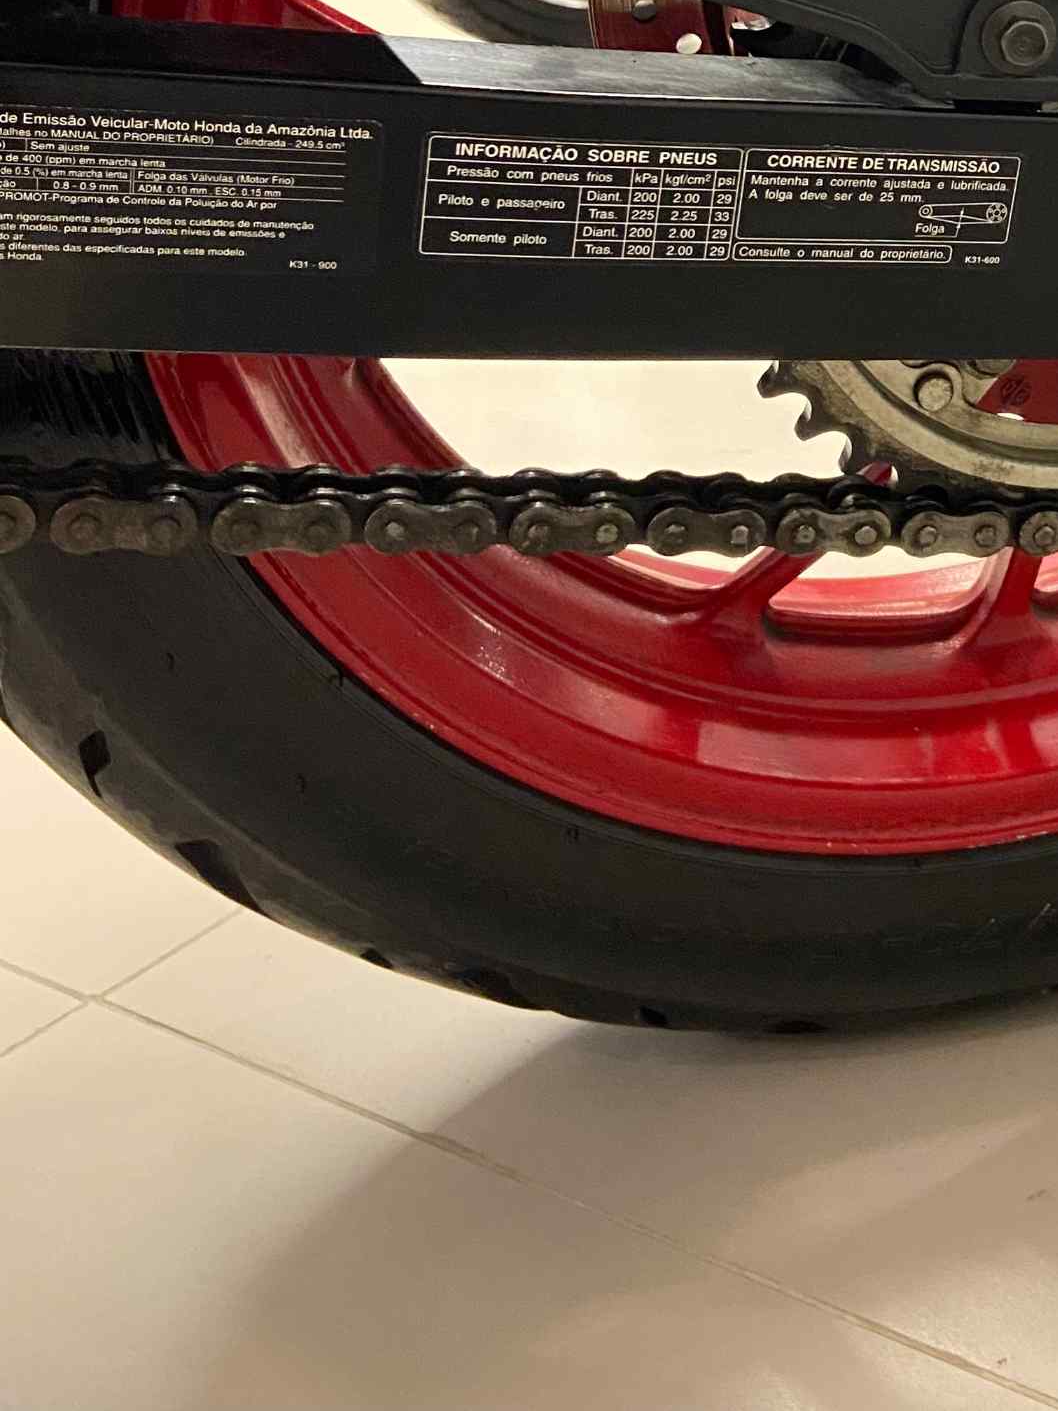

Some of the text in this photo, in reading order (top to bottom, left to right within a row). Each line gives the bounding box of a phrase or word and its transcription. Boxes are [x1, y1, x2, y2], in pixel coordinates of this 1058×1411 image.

[0, 112, 374, 139] de Emissão Veicular-Moto Honda da Amazônia Ltda.
[34, 130, 48, 138] no
[51, 130, 100, 140] MANUAL
[103, 131, 120, 141] DO
[123, 132, 214, 145] PROPRIETÁRIO)
[235, 136, 286, 148] Cilindrada
[295, 139, 323, 149] 249.5
[30, 141, 90, 153] Sem ajuste
[455, 142, 718, 165] INFORMAÇÃO SOBRE PNEUS
[5, 154, 19, 162] de
[22, 154, 42, 163] 400
[45, 156, 76, 166] (ppm)
[98, 158, 138, 167] marcha
[141, 159, 166, 168] lenta
[767, 154, 1000, 174] CORRENTE DE TRANSMISSÃO
[1, 167, 12, 175] de
[15, 167, 30, 176] 0.5
[51, 169, 66, 177] em
[68, 169, 103, 178] marcha
[105, 170, 128, 179] lenta
[137, 170, 295, 186] Folga das Válvulas (Motor Frio)
[447, 165, 613, 183] Pressão com pneus frios
[634, 172, 736, 187] kPa kgf/cm² psi
[53, 180, 70, 190] 0.8
[80, 182, 97, 191] 0.9
[751, 175, 809, 186] Mantenha
[830, 177, 878, 188] corrente
[883, 178, 931, 190] ajustada
[937, 181, 945, 189] e
[166, 185, 188, 195] 0.10
[241, 188, 261, 197] 0.15
[264, 189, 281, 197] mm
[586, 191, 732, 204] Diant. 200 2.00 29
[748, 189, 758, 199] A
[765, 189, 793, 202] folga
[800, 190, 828, 200] deve
[834, 192, 853, 201] ser
[858, 191, 874, 202] de
[880, 191, 895, 202] 25
[106, 195, 120, 203] de
[122, 196, 166, 205] Controle
[169, 198, 182, 206] da
[185, 198, 229, 209] Poluição
[230, 200, 244, 208] do
[246, 200, 257, 208] Ar
[260, 202, 277, 210] por
[438, 193, 565, 211] Piloto e passageiro
[16, 213, 91, 223] rigorosamente
[94, 216, 140, 226] seguidos
[143, 217, 172, 225] todos
[189, 218, 235, 227] cuidados
[237, 220, 250, 228] de
[253, 220, 314, 231] manutenção
[589, 209, 730, 222] Tras. 225 2.25 33
[63, 225, 88, 234] para
[91, 226, 142, 236] assegurar
[144, 227, 178, 235] baixos
[213, 229, 226, 237] de
[228, 229, 276, 239] emissões
[278, 231, 286, 239] e
[582, 226, 728, 239] Diant. 200 2.00 29
[915, 222, 945, 236] Folga
[449, 231, 547, 246] Somente piloto
[8, 242, 60, 251] diferentes
[62, 244, 82, 252] das
[84, 244, 155, 256] especificadas
[157, 247, 181, 256] para
[183, 248, 205, 256] este
[584, 244, 725, 256] Tras. 200 2.00 29
[739, 246, 946, 261] Consulte o manual do proprietário.
